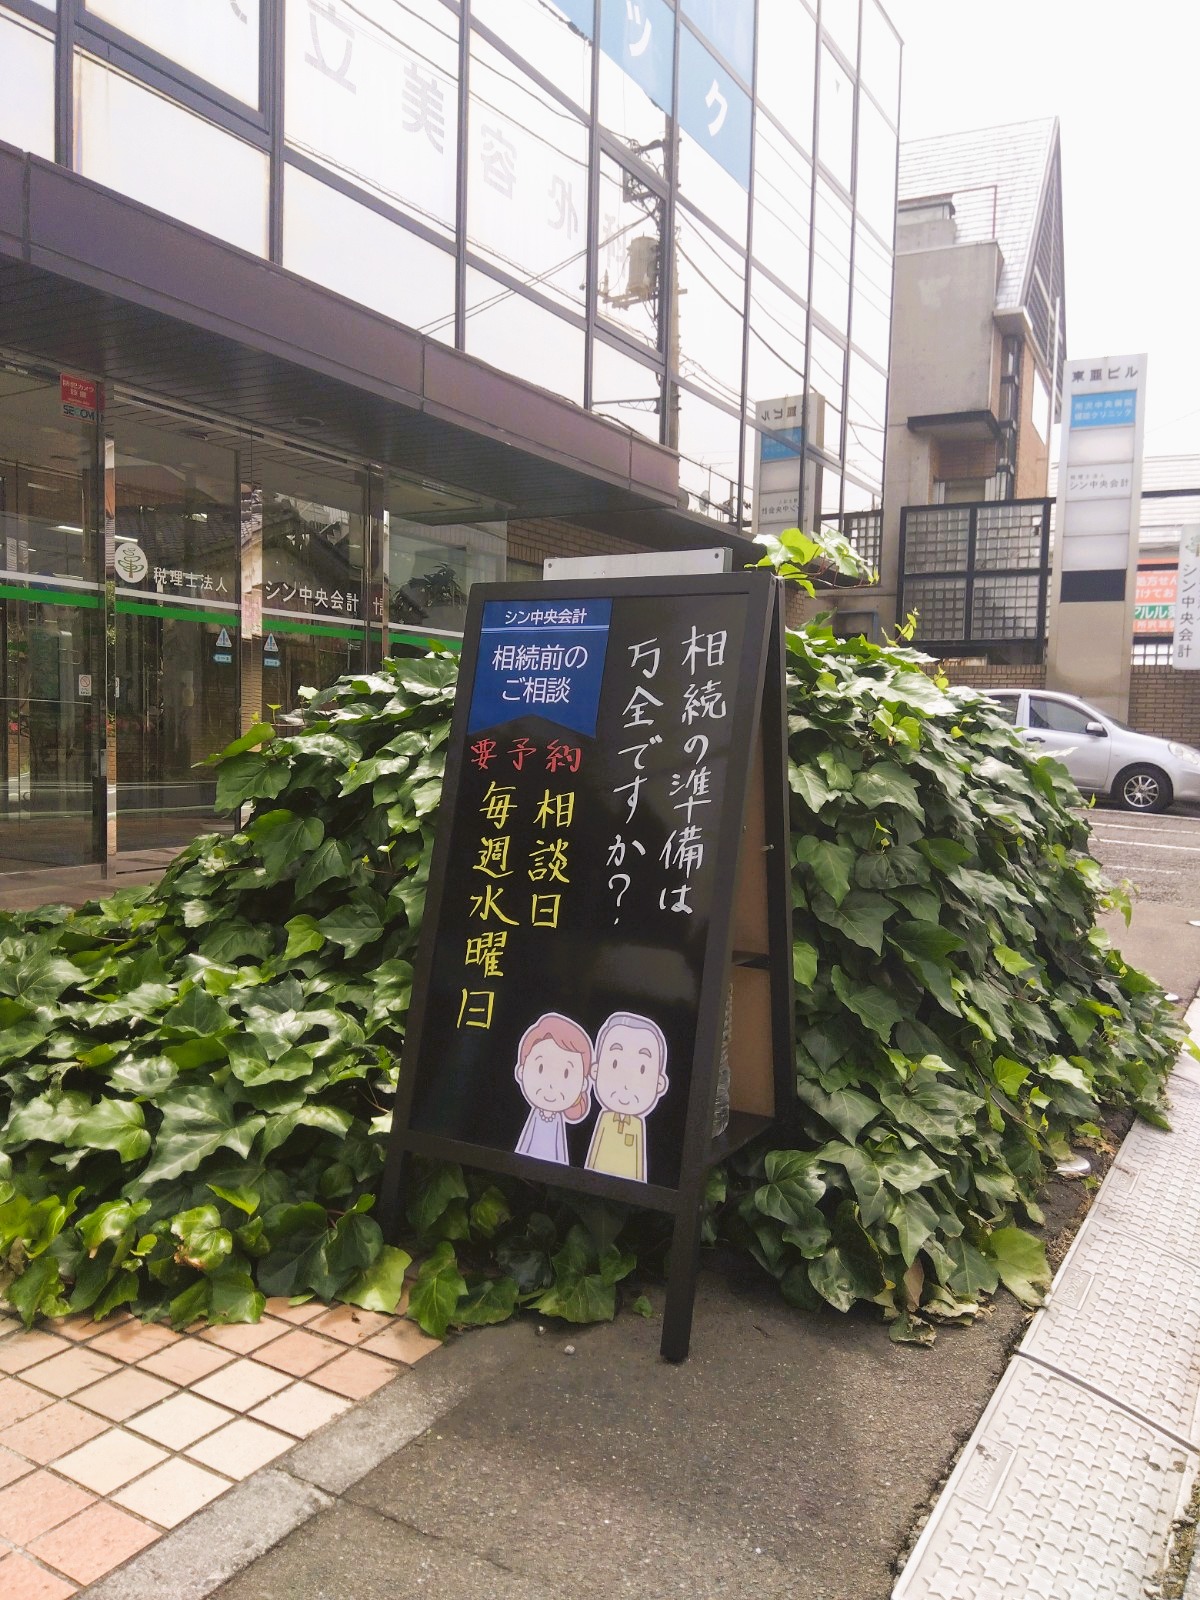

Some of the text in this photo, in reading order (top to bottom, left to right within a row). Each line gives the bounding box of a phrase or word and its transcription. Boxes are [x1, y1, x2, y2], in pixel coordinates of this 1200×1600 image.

[1070, 478, 1129, 491] シン中央会計
[153, 566, 228, 593] 税理士法人
[265, 580, 360, 613] シン中央会計
[504, 609, 588, 626] シン中央会計
[1177, 564, 1197, 658] シン中央会計
[492, 644, 589, 672] 相続前の
[501, 677, 570, 705] ご相談
[470, 737, 583, 774] 要予約
[659, 624, 729, 916] 相続の準備は
[606, 637, 664, 926] 万全ですか？
[527, 789, 576, 929] 相談日
[456, 780, 519, 1030] 毎週水曜日
